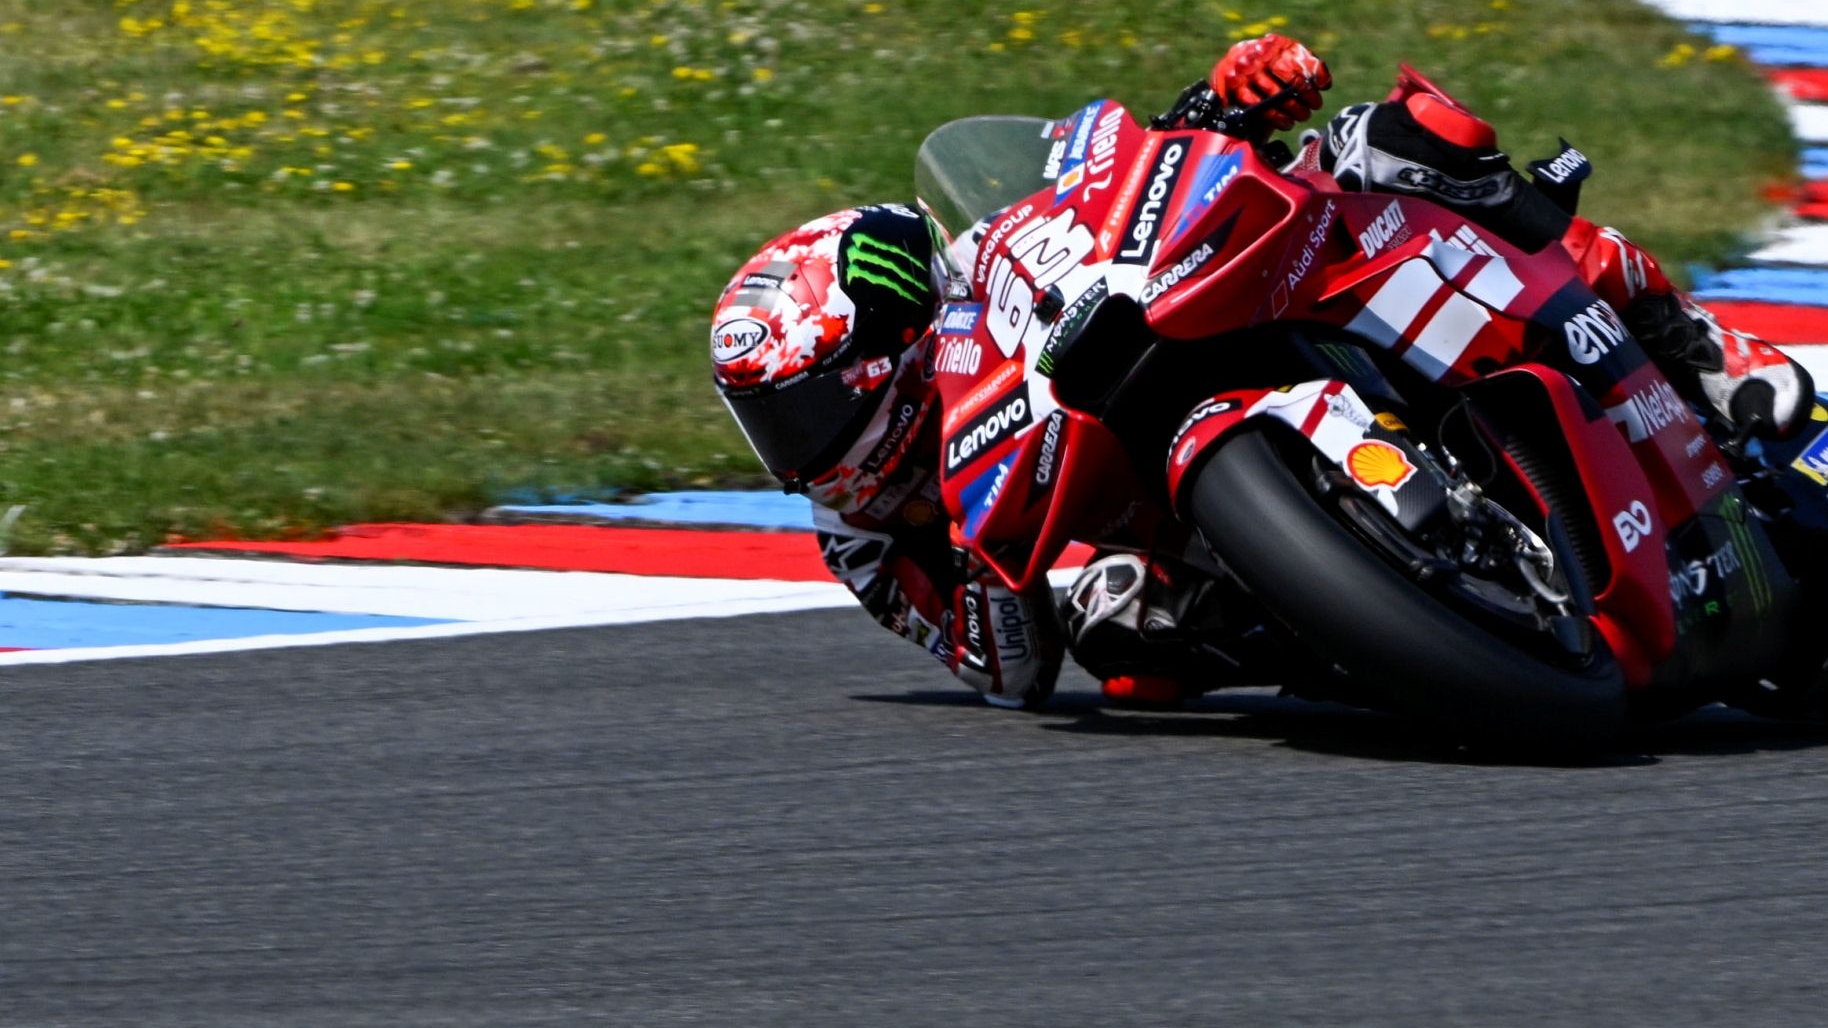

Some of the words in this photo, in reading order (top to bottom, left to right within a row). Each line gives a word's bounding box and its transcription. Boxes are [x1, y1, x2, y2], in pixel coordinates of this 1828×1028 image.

[1203, 165, 1239, 203] TIM
[1538, 148, 1587, 184] Lenovo
[1120, 144, 1183, 257] Lenovo
[1309, 199, 1337, 249] Sport
[1358, 199, 1406, 260] DUCATI
[976, 204, 1034, 283] VARGROUP
[1141, 243, 1215, 305] CARRERA
[987, 207, 1096, 359] 63
[713, 332, 760, 349] SUOMY
[1046, 280, 1108, 353] MONSTER
[866, 356, 893, 379] 63
[867, 403, 914, 469] Lenovo
[948, 397, 1027, 469] Lenovo
[1036, 412, 1063, 484] CARRERA
[984, 463, 1009, 507] TIM
[990, 595, 1033, 663] Unipol
